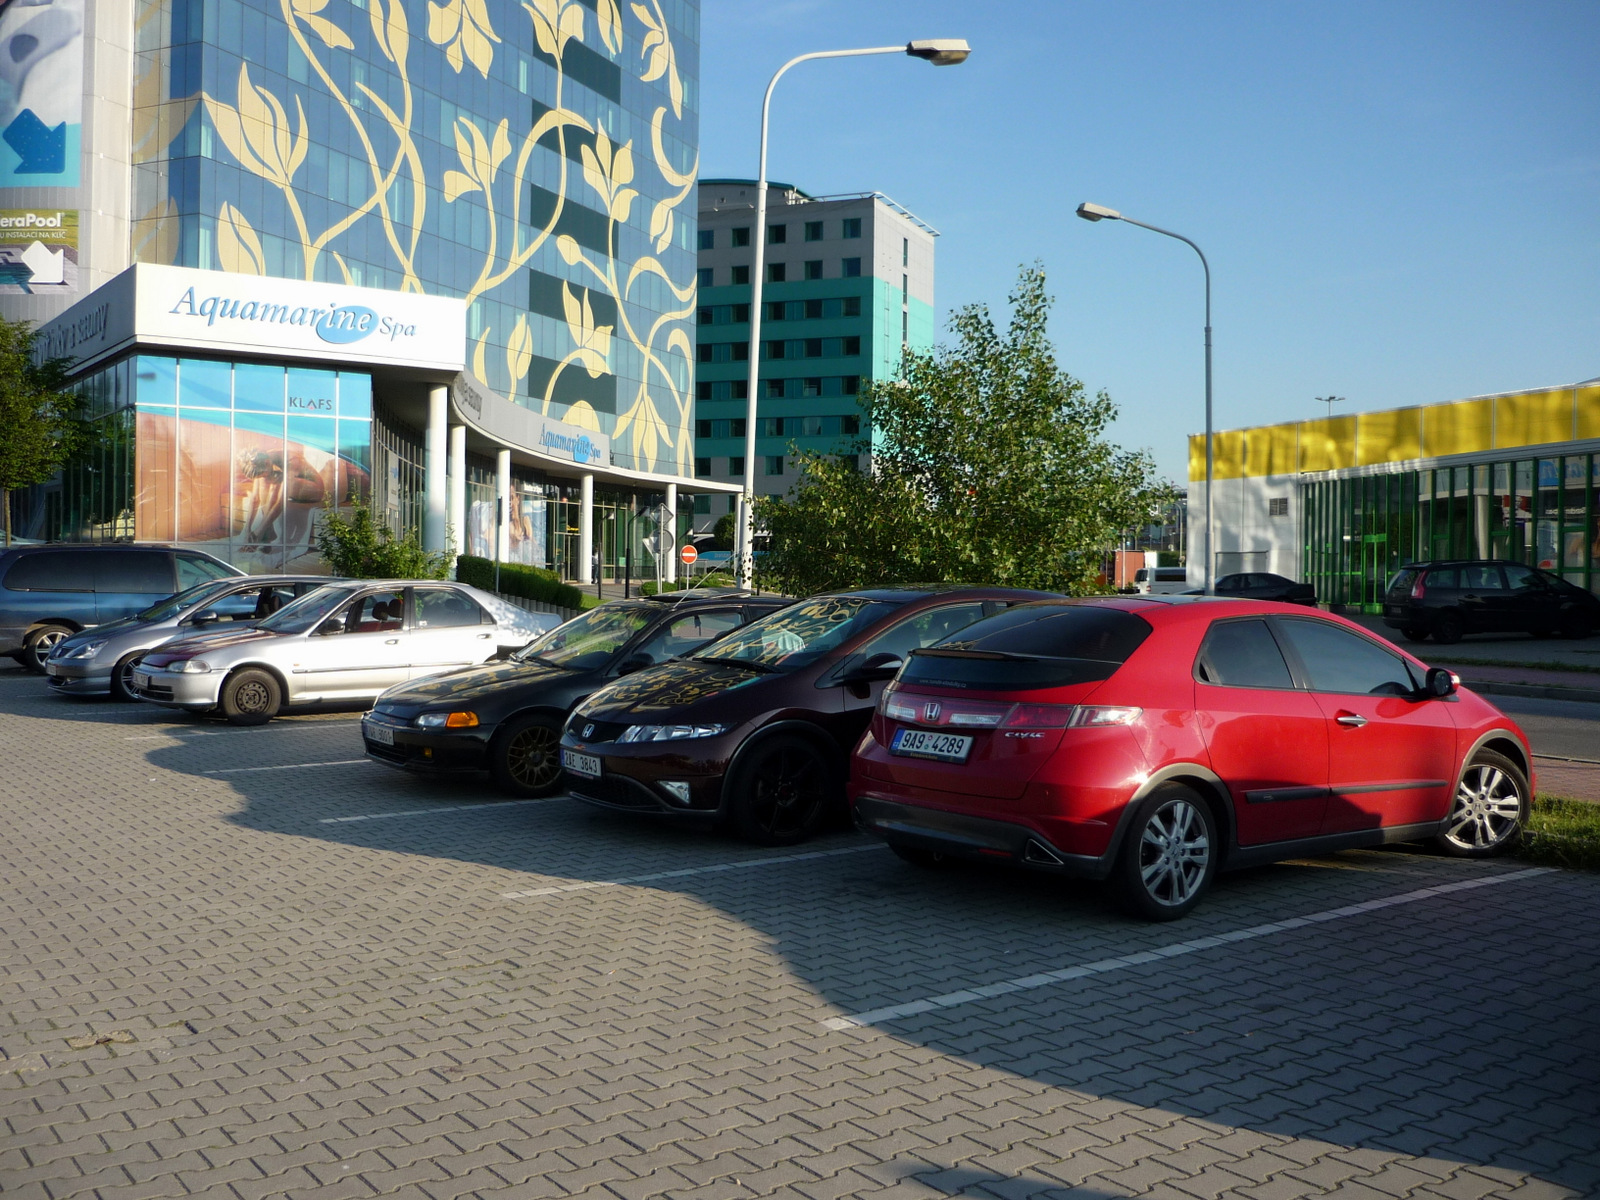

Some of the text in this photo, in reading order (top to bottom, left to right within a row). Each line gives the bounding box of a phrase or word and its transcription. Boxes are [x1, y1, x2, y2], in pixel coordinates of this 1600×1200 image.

[169, 286, 417, 342] Aquamarine Spa
[289, 396, 332, 411] KLAFS
[538, 422, 602, 463] Aquamarine Spa
[902, 732, 926, 750] 9A9
[932, 735, 965, 755] 4289
[1004, 731, 1046, 740] CIVIC
[580, 756, 598, 774] 3843
